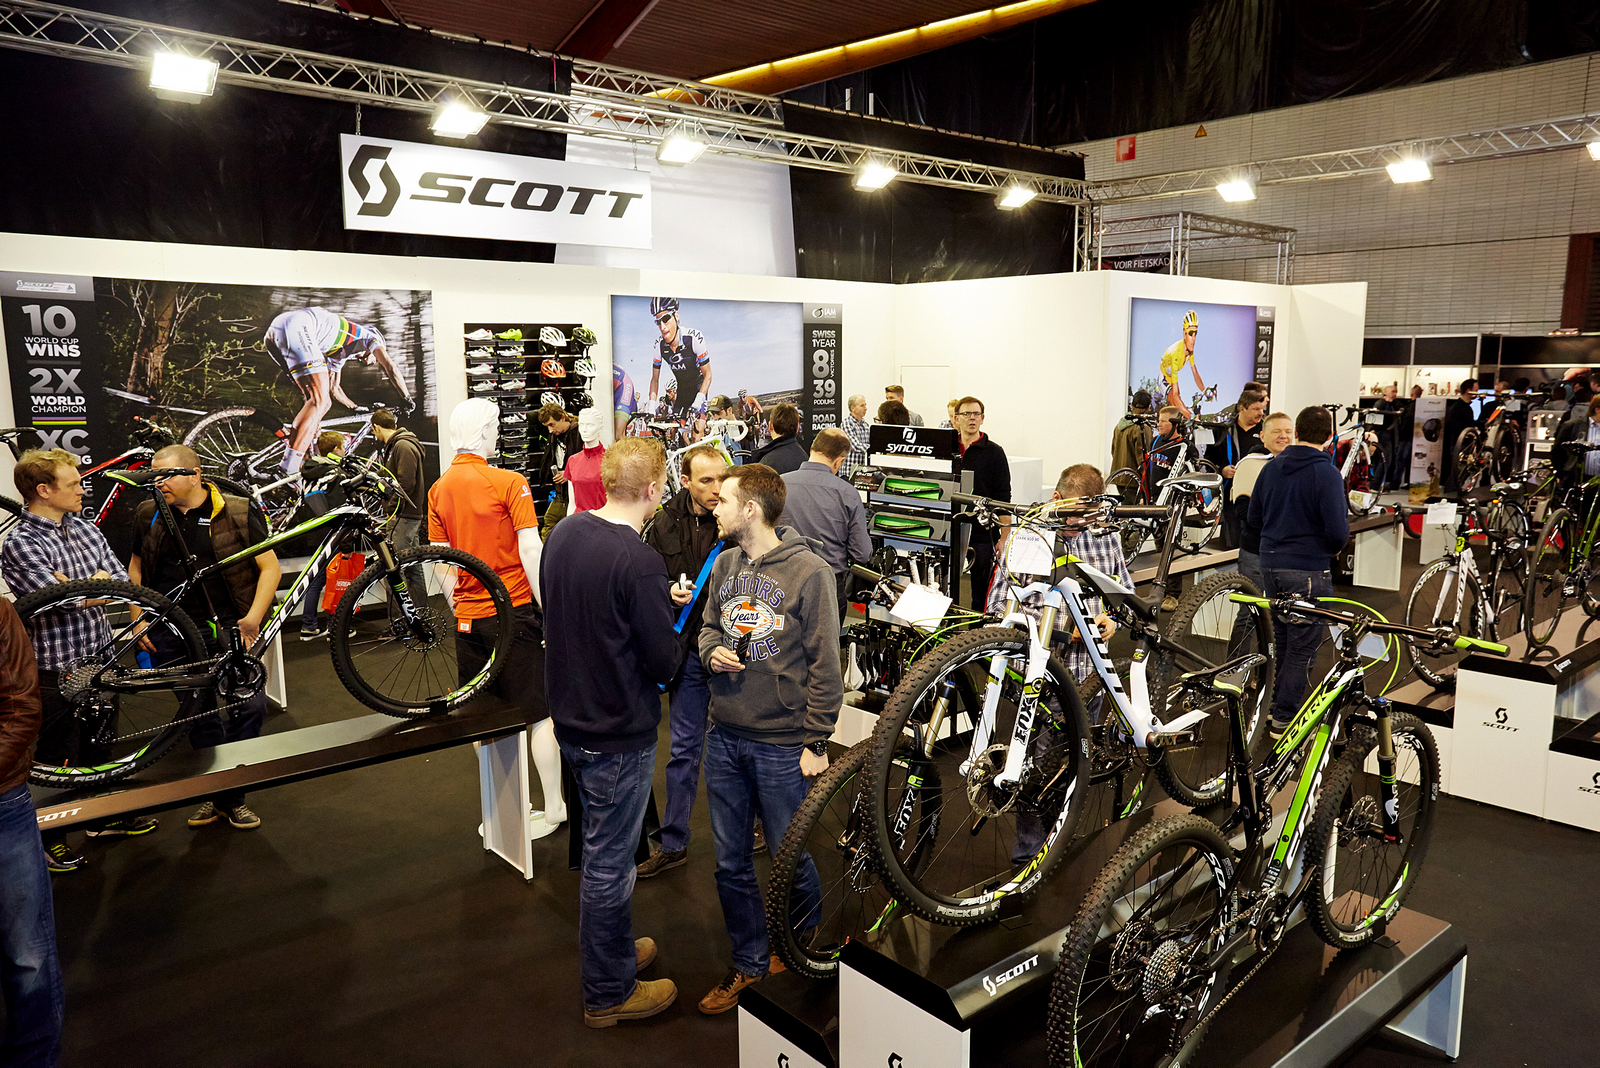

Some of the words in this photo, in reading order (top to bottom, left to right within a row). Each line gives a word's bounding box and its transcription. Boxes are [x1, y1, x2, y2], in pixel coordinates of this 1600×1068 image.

[410, 171, 644, 219] SCOTT
[1113, 261, 1132, 269] VOIR
[21, 304, 77, 338] 10
[24, 336, 59, 344] WORLD
[60, 337, 79, 345] CUP
[812, 330, 836, 339] SWISS
[24, 343, 81, 358] WINS
[812, 349, 830, 379] 8
[28, 367, 84, 395] 2X
[812, 379, 836, 399] 39
[30, 395, 86, 406] WORLD
[813, 398, 836, 406] PODIUMS
[31, 405, 87, 414] CHAMPION
[812, 413, 836, 423] ROAD
[885, 442, 934, 455] syncros
[264, 535, 334, 646] SCOTT
[729, 603, 761, 630] Gears
[1013, 695, 1039, 747] FOX
[1482, 721, 1520, 732] SCOTT
[37, 807, 82, 824] COTT
[995, 953, 1040, 988] SCOTT
